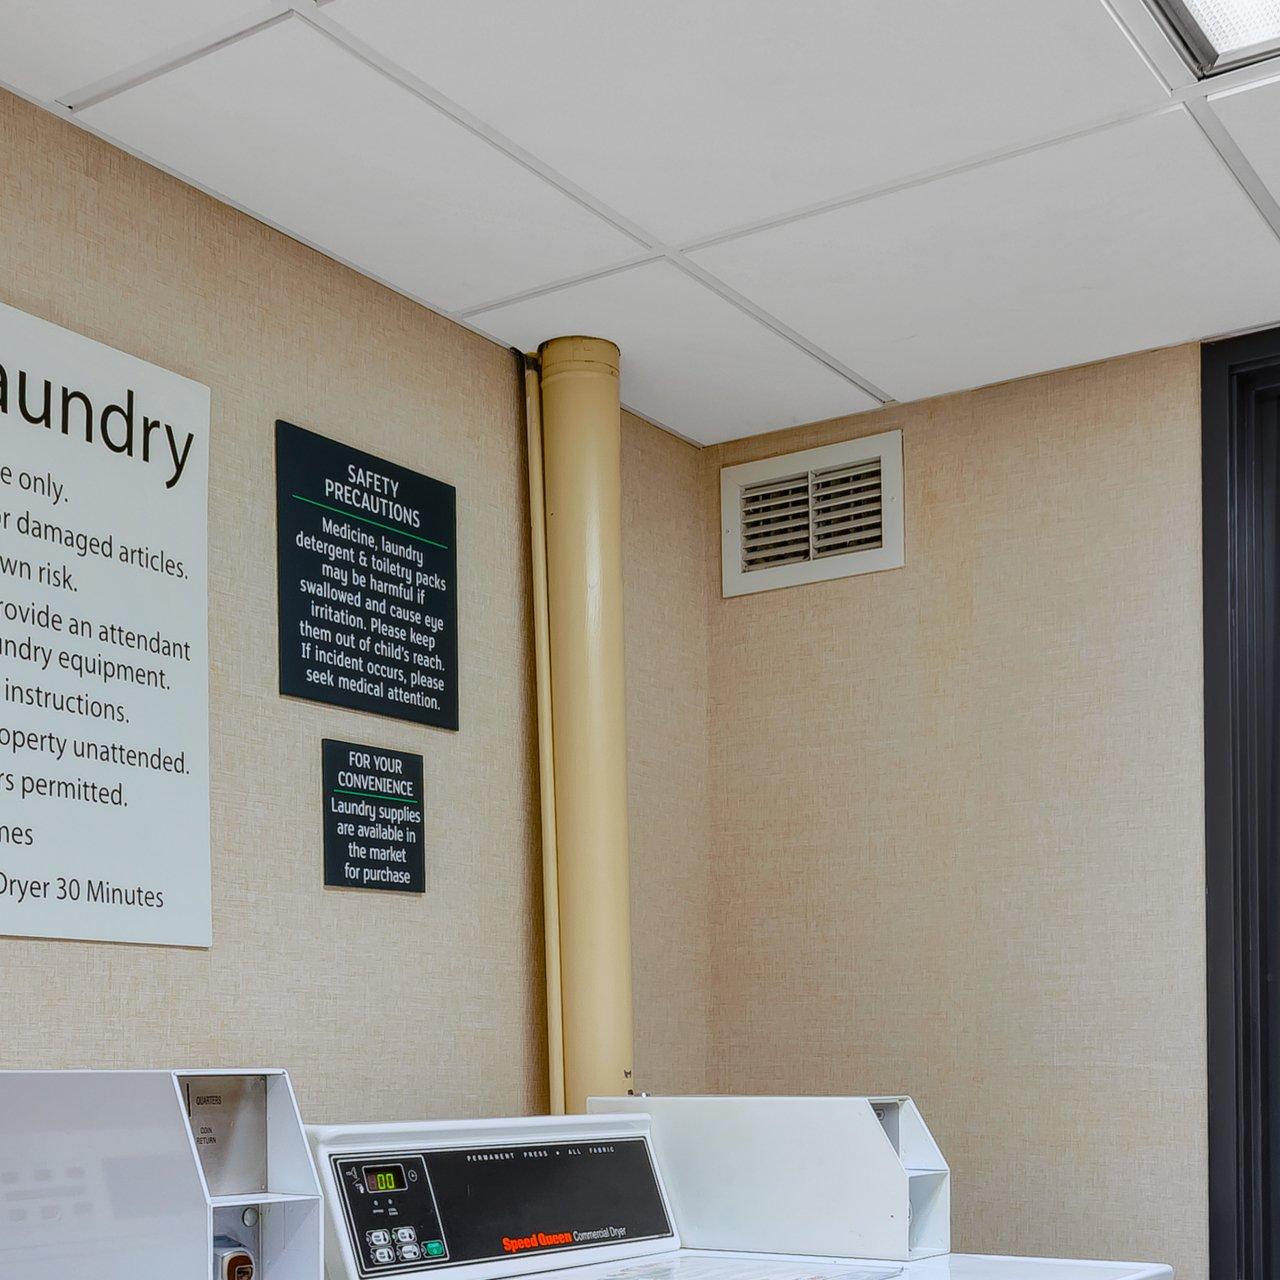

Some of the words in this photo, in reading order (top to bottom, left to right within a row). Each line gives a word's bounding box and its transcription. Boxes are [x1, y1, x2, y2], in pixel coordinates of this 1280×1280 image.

[18, 471, 67, 505] only.
[347, 463, 399, 498] SAFETY
[325, 478, 420, 528] PRECAUTIONS
[16, 510, 112, 558] damaged
[118, 545, 187, 579] articles.
[322, 516, 377, 551] Medicine,
[381, 535, 423, 567] laundry
[38, 561, 77, 592] risk.
[295, 530, 355, 563] detergent
[358, 550, 367, 567] &
[371, 554, 411, 584] toiletry
[415, 571, 446, 591] packs
[321, 563, 347, 586] may
[351, 568, 366, 587] be
[369, 573, 413, 601] harmful
[417, 588, 425, 605] if
[299, 579, 360, 607] swallowed
[364, 597, 386, 614] and
[389, 604, 421, 624] cause
[424, 614, 443, 632] eye
[68, 617, 91, 638] an
[98, 623, 190, 661] attendant
[311, 599, 366, 630] irritation.
[370, 617, 406, 640] Please
[409, 627, 435, 651] keep
[299, 619, 331, 642] them
[335, 632, 355, 648] out
[358, 636, 371, 652] of
[374, 639, 409, 662] child's
[412, 652, 445, 671] reach.
[58, 651, 169, 690] equipment.
[301, 642, 311, 659] If
[315, 644, 363, 672] incident
[366, 661, 406, 684] occurs,
[410, 669, 444, 691] please
[5, 677, 129, 723] instructions.
[306, 668, 334, 686] seek
[338, 676, 383, 697] medical
[387, 686, 440, 710] attention.
[73, 739, 189, 774] unattended.
[349, 750, 370, 769] FOR
[372, 755, 402, 774] YOUR
[21, 775, 127, 807] permitted.
[337, 770, 413, 796] CONVENIENCE
[331, 796, 375, 821] Laundry
[378, 805, 420, 824] supplies
[336, 822, 354, 836] are
[357, 823, 403, 841] available
[405, 826, 416, 843] in
[347, 841, 366, 858] the
[369, 845, 406, 862] market
[344, 861, 360, 879] for
[363, 865, 410, 884] purchase
[56, 877, 80, 900] 30
[86, 879, 163, 907] Minutes
[502, 1234, 538, 1252] Speed
[539, 1231, 572, 1247] Queen
[573, 1227, 609, 1242] Commercial
[610, 1226, 626, 1238] Dryer
